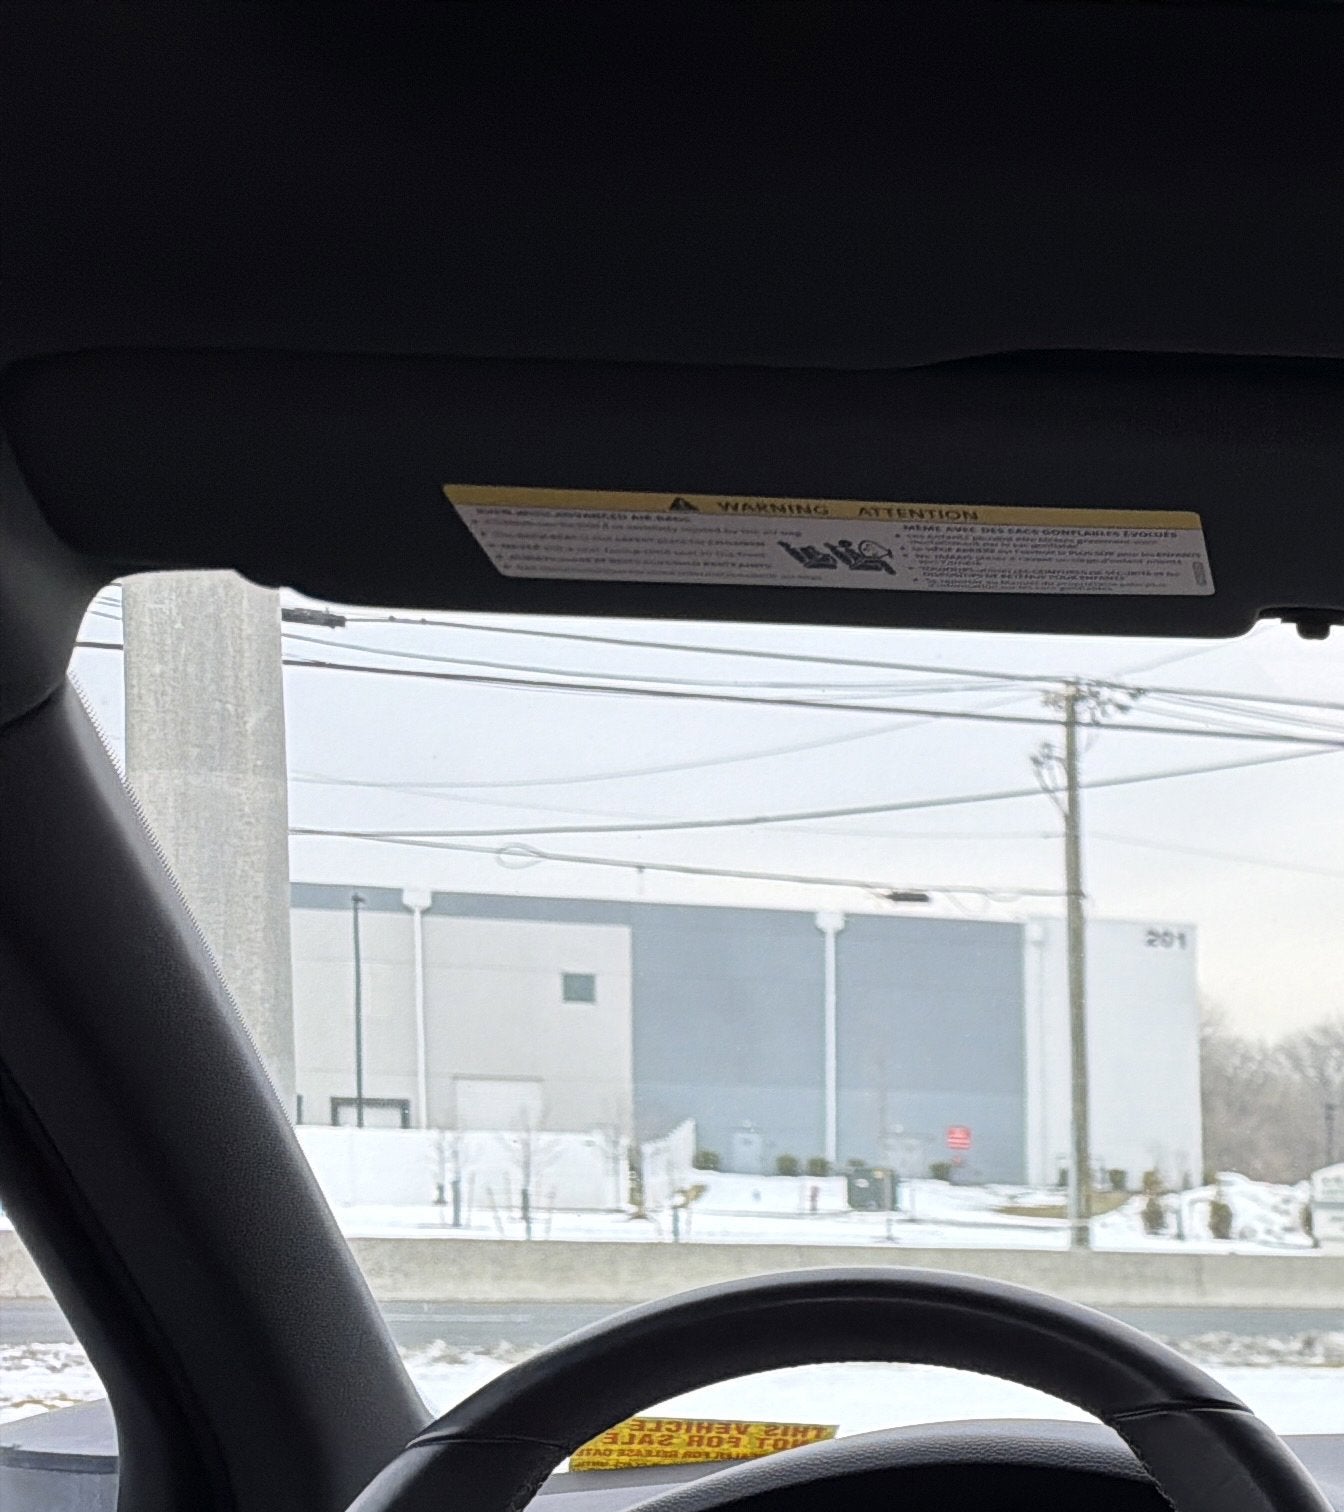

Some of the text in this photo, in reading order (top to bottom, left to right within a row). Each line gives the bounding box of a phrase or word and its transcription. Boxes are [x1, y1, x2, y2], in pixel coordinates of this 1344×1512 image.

[717, 502, 978, 521] WARNING ATTENTION
[1145, 929, 1187, 950] 201
